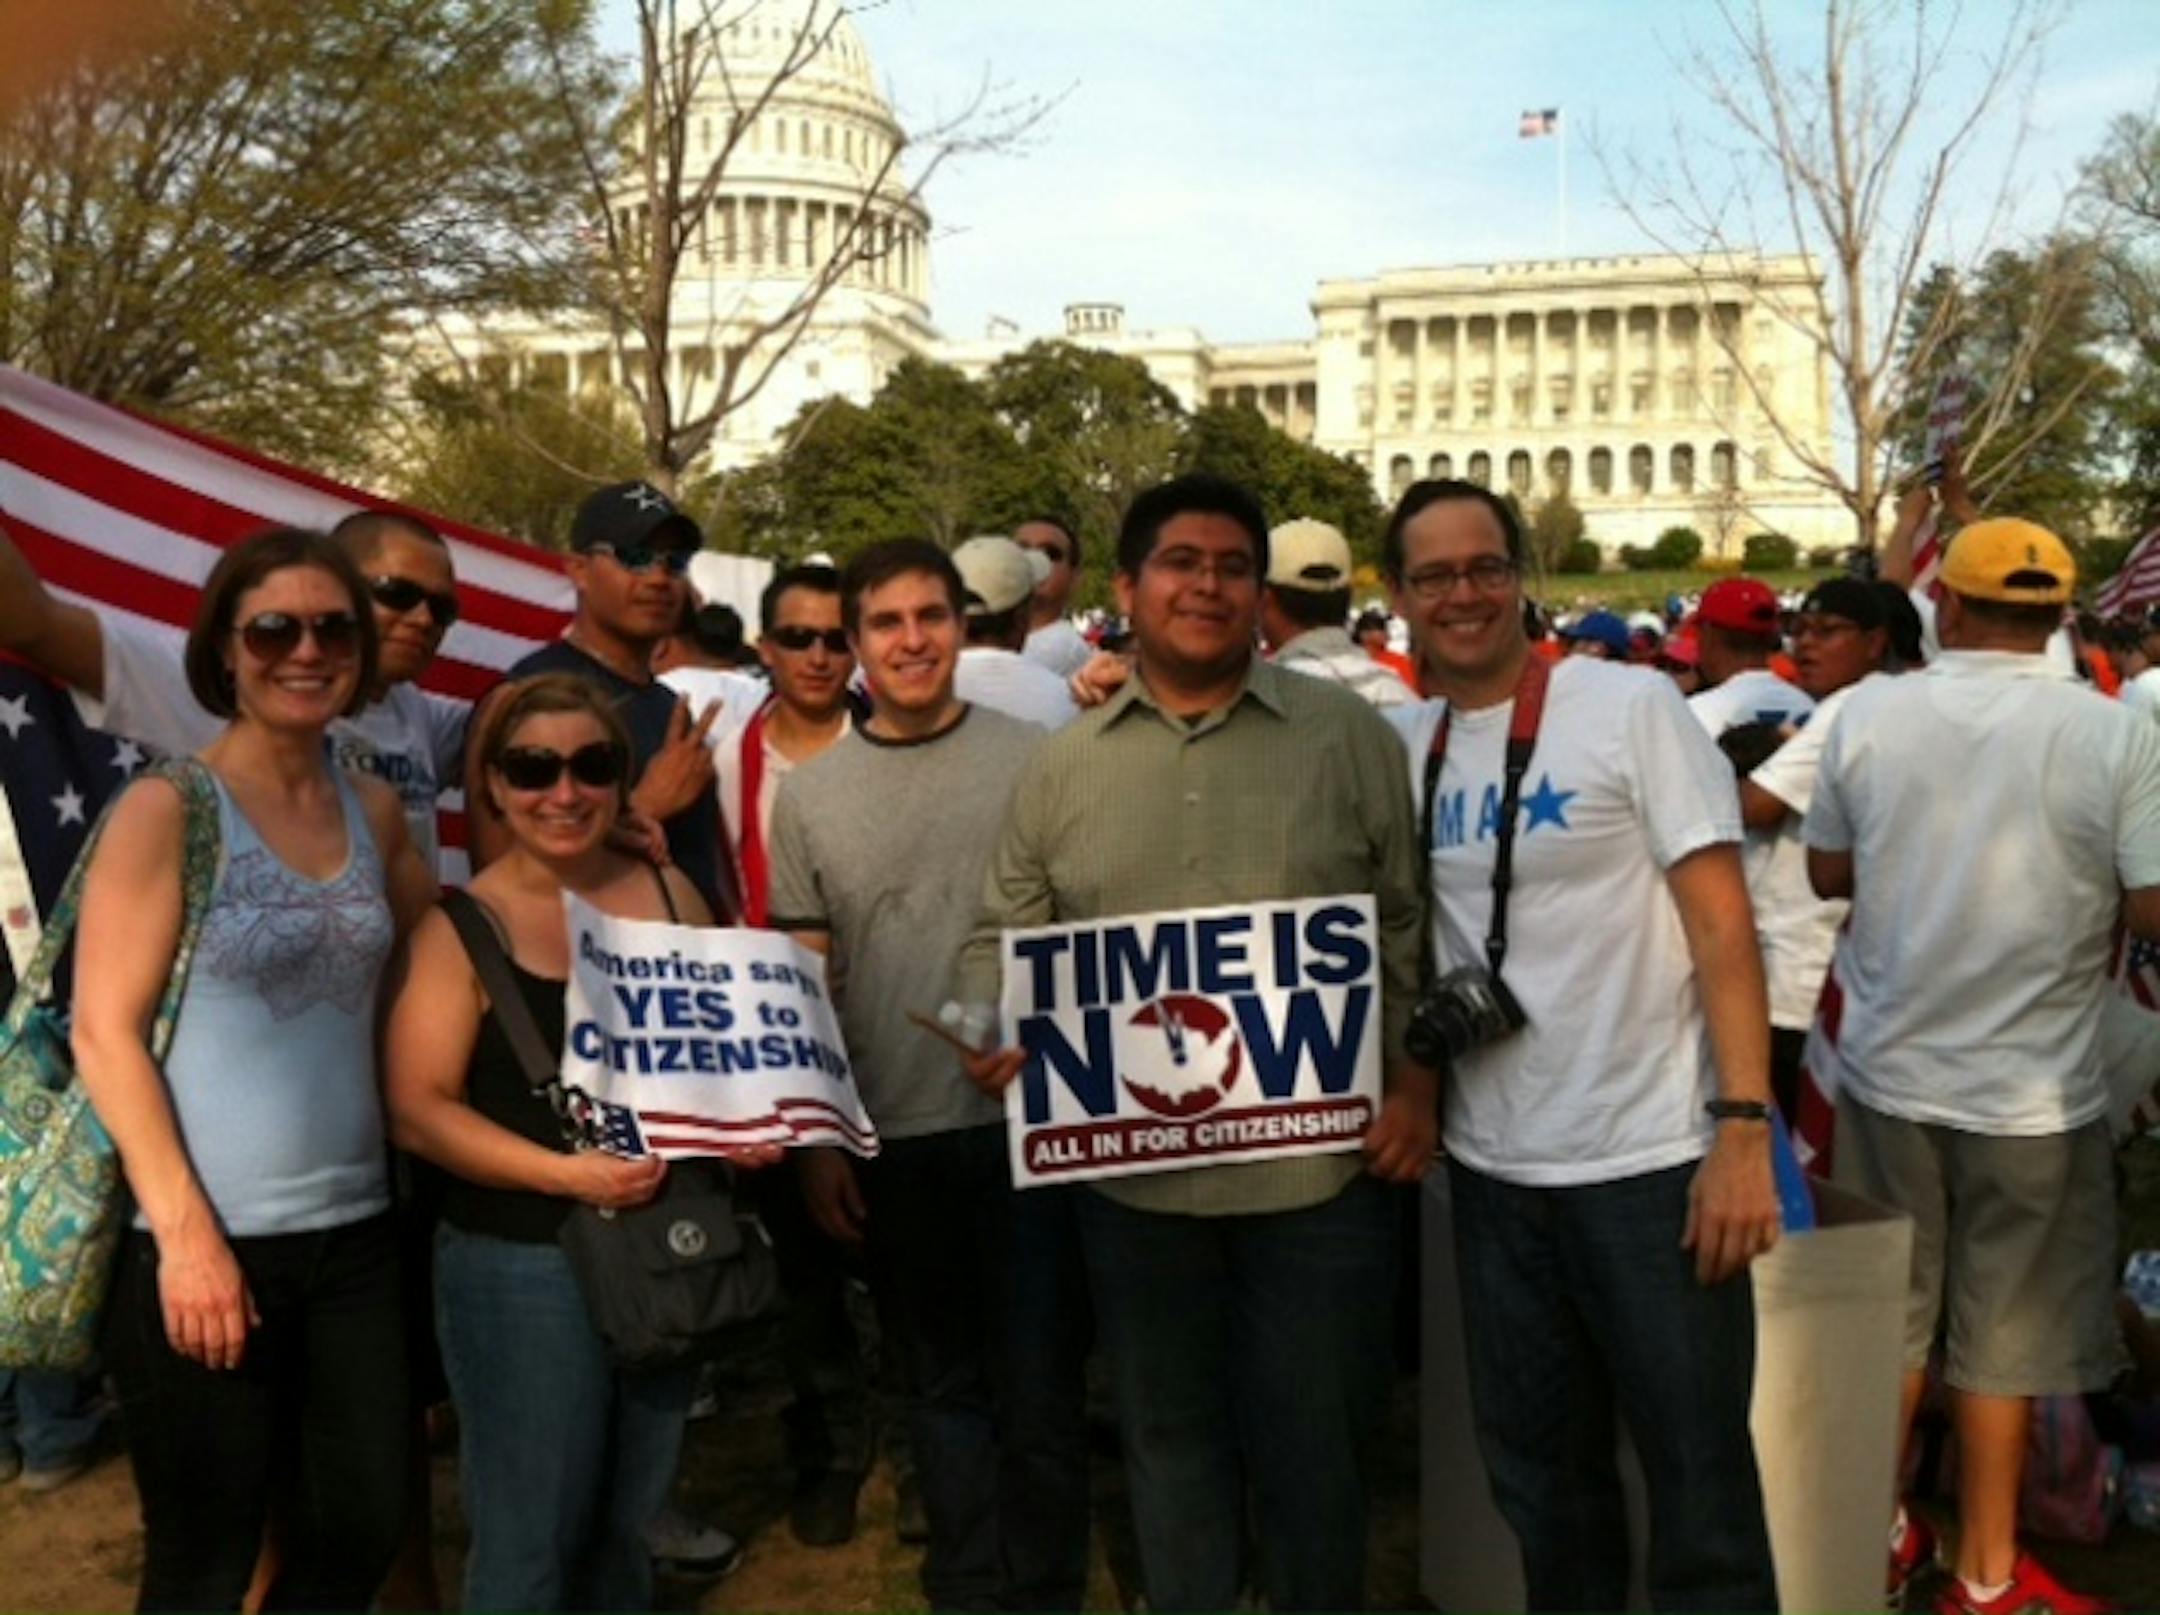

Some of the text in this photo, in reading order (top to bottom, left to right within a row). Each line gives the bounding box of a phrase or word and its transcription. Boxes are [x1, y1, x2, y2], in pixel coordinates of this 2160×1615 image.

[580, 929, 734, 983] America
[1014, 905, 1373, 1011] TIME IS
[614, 985, 800, 1031] YES to
[571, 1021, 848, 1081] CITIZENSHIP
[1018, 984, 1374, 1124] NOW
[1031, 1108, 1368, 1167] ALL IN FOR CITIZENSHIP
